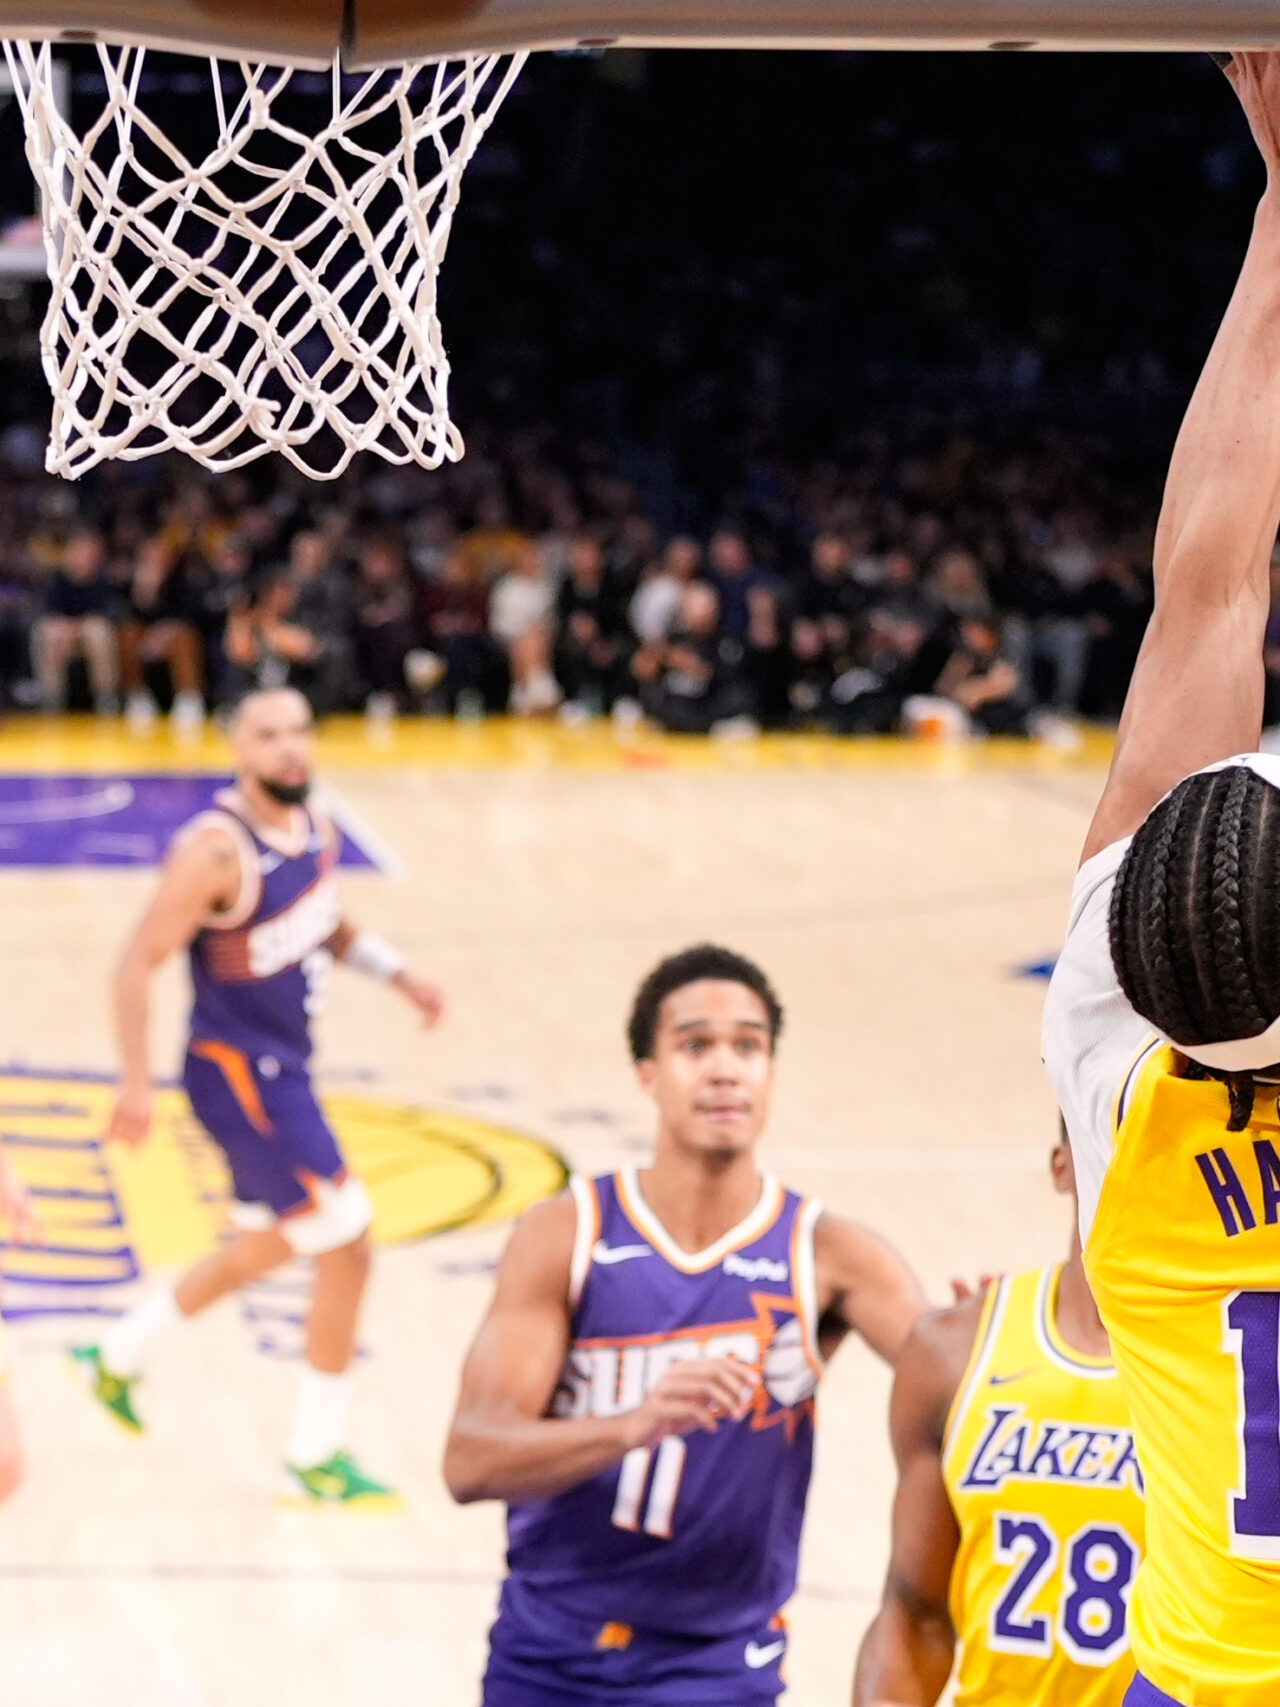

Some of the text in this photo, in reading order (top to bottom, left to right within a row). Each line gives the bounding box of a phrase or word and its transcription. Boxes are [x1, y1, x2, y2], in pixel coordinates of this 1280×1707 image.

[610, 1434, 688, 1540] 11
[960, 1404, 1145, 1500] LAKER
[988, 1511, 1140, 1668] 28
